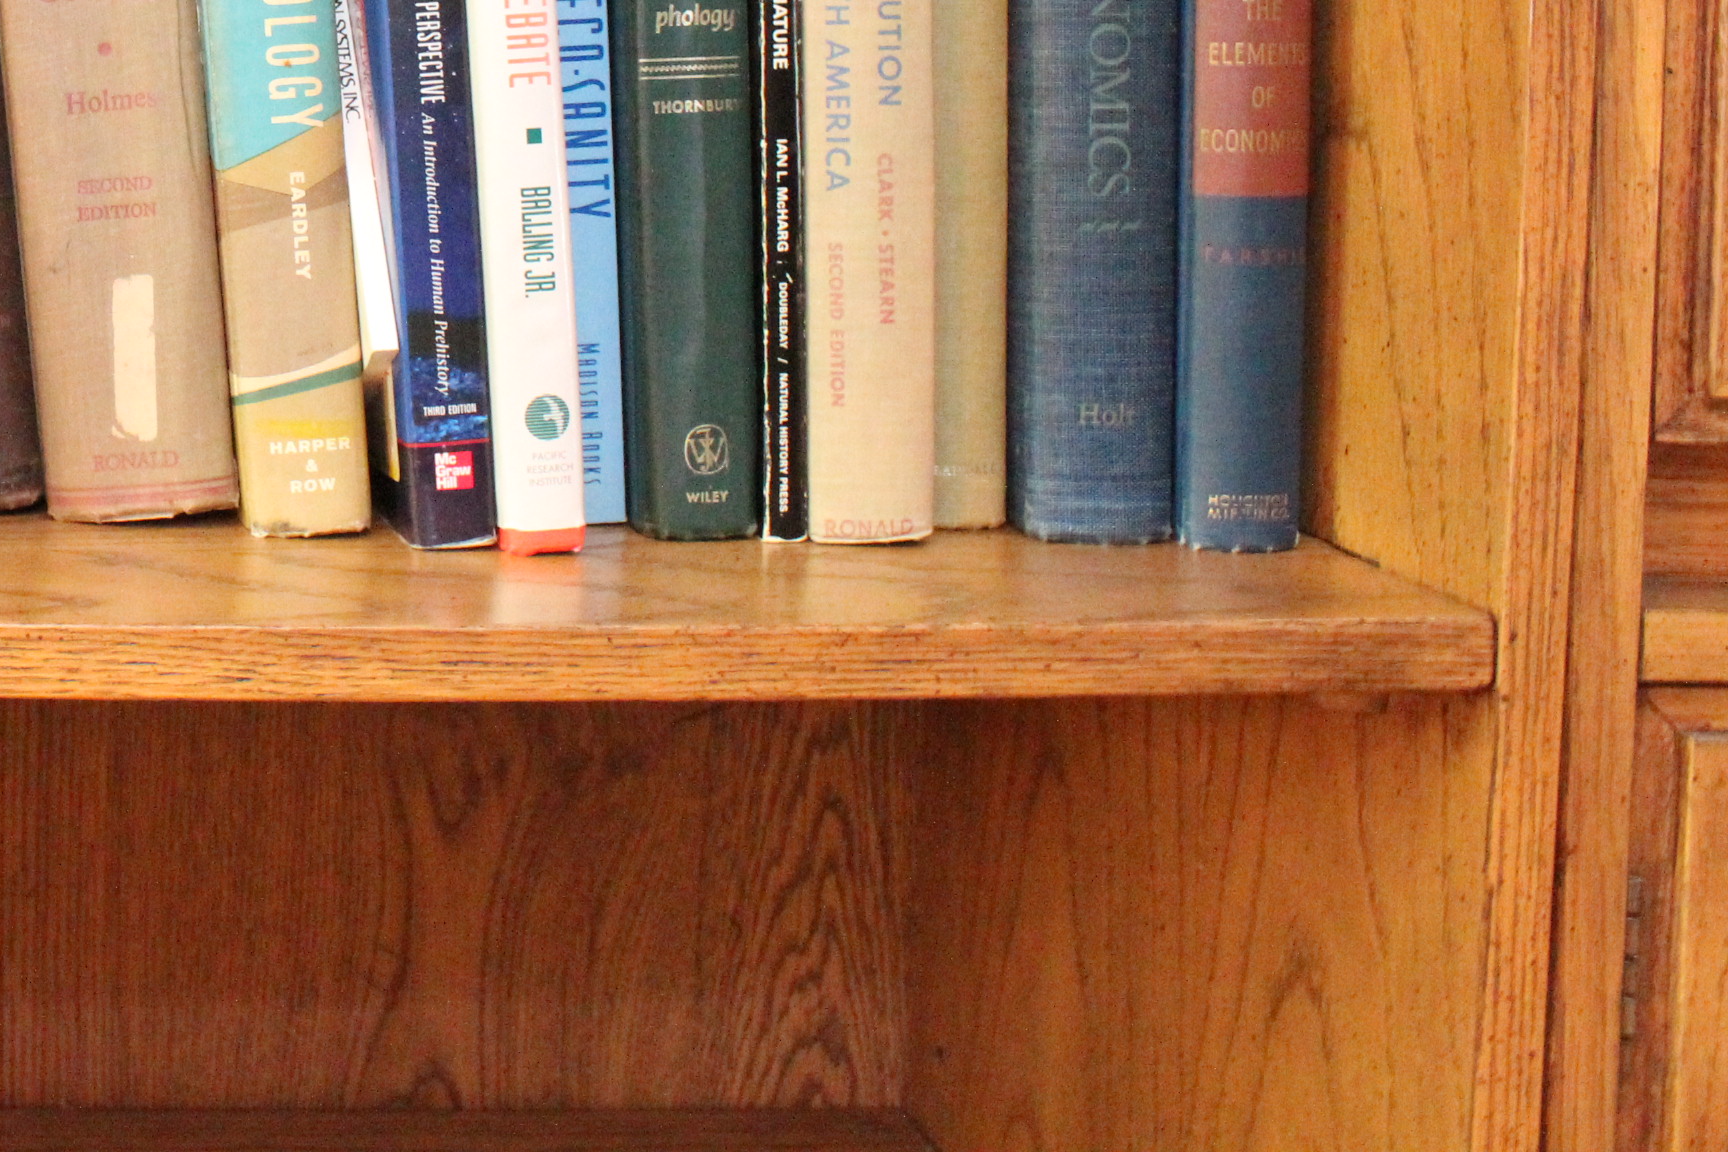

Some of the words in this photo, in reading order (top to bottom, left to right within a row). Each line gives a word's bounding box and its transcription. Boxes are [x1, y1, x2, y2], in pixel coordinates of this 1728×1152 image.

[655, 3, 736, 33] phology
[414, 1, 446, 105] PERSPECTIVE
[66, 90, 157, 116] Holmes
[825, 40, 851, 192] AMERICA
[421, 112, 436, 135] An
[776, 138, 788, 167] IAN
[77, 176, 153, 195] SECOND
[423, 139, 442, 234] Introduction
[776, 169, 788, 183] L.
[876, 152, 894, 221] CLARK
[77, 203, 157, 223] EDITION
[289, 171, 312, 280] EARDLEY
[521, 186, 555, 266] BALLING
[776, 186, 789, 253] McHARG
[429, 236, 442, 253] to
[430, 258, 445, 315] Human
[523, 271, 557, 300] JR.
[828, 242, 845, 320] SECOND
[877, 243, 896, 325] STEARN
[778, 282, 789, 349] DOUBLEDAY
[434, 319, 450, 396] Prehistory
[829, 327, 847, 407] EDITION
[423, 404, 446, 416] THIRD
[447, 403, 477, 415] EDITION
[778, 373, 788, 423] NATURAL
[1078, 404, 1136, 427] Holt
[270, 436, 351, 455] HARPER
[435, 452, 456, 465] Mc
[778, 426, 789, 474] HISTORY
[92, 451, 180, 473] RONALD
[305, 458, 318, 473] &
[435, 465, 472, 478] Graw
[290, 476, 337, 494] ROW
[436, 476, 458, 490] Hill
[687, 490, 728, 504] WILEY
[824, 518, 915, 538] RONALD
